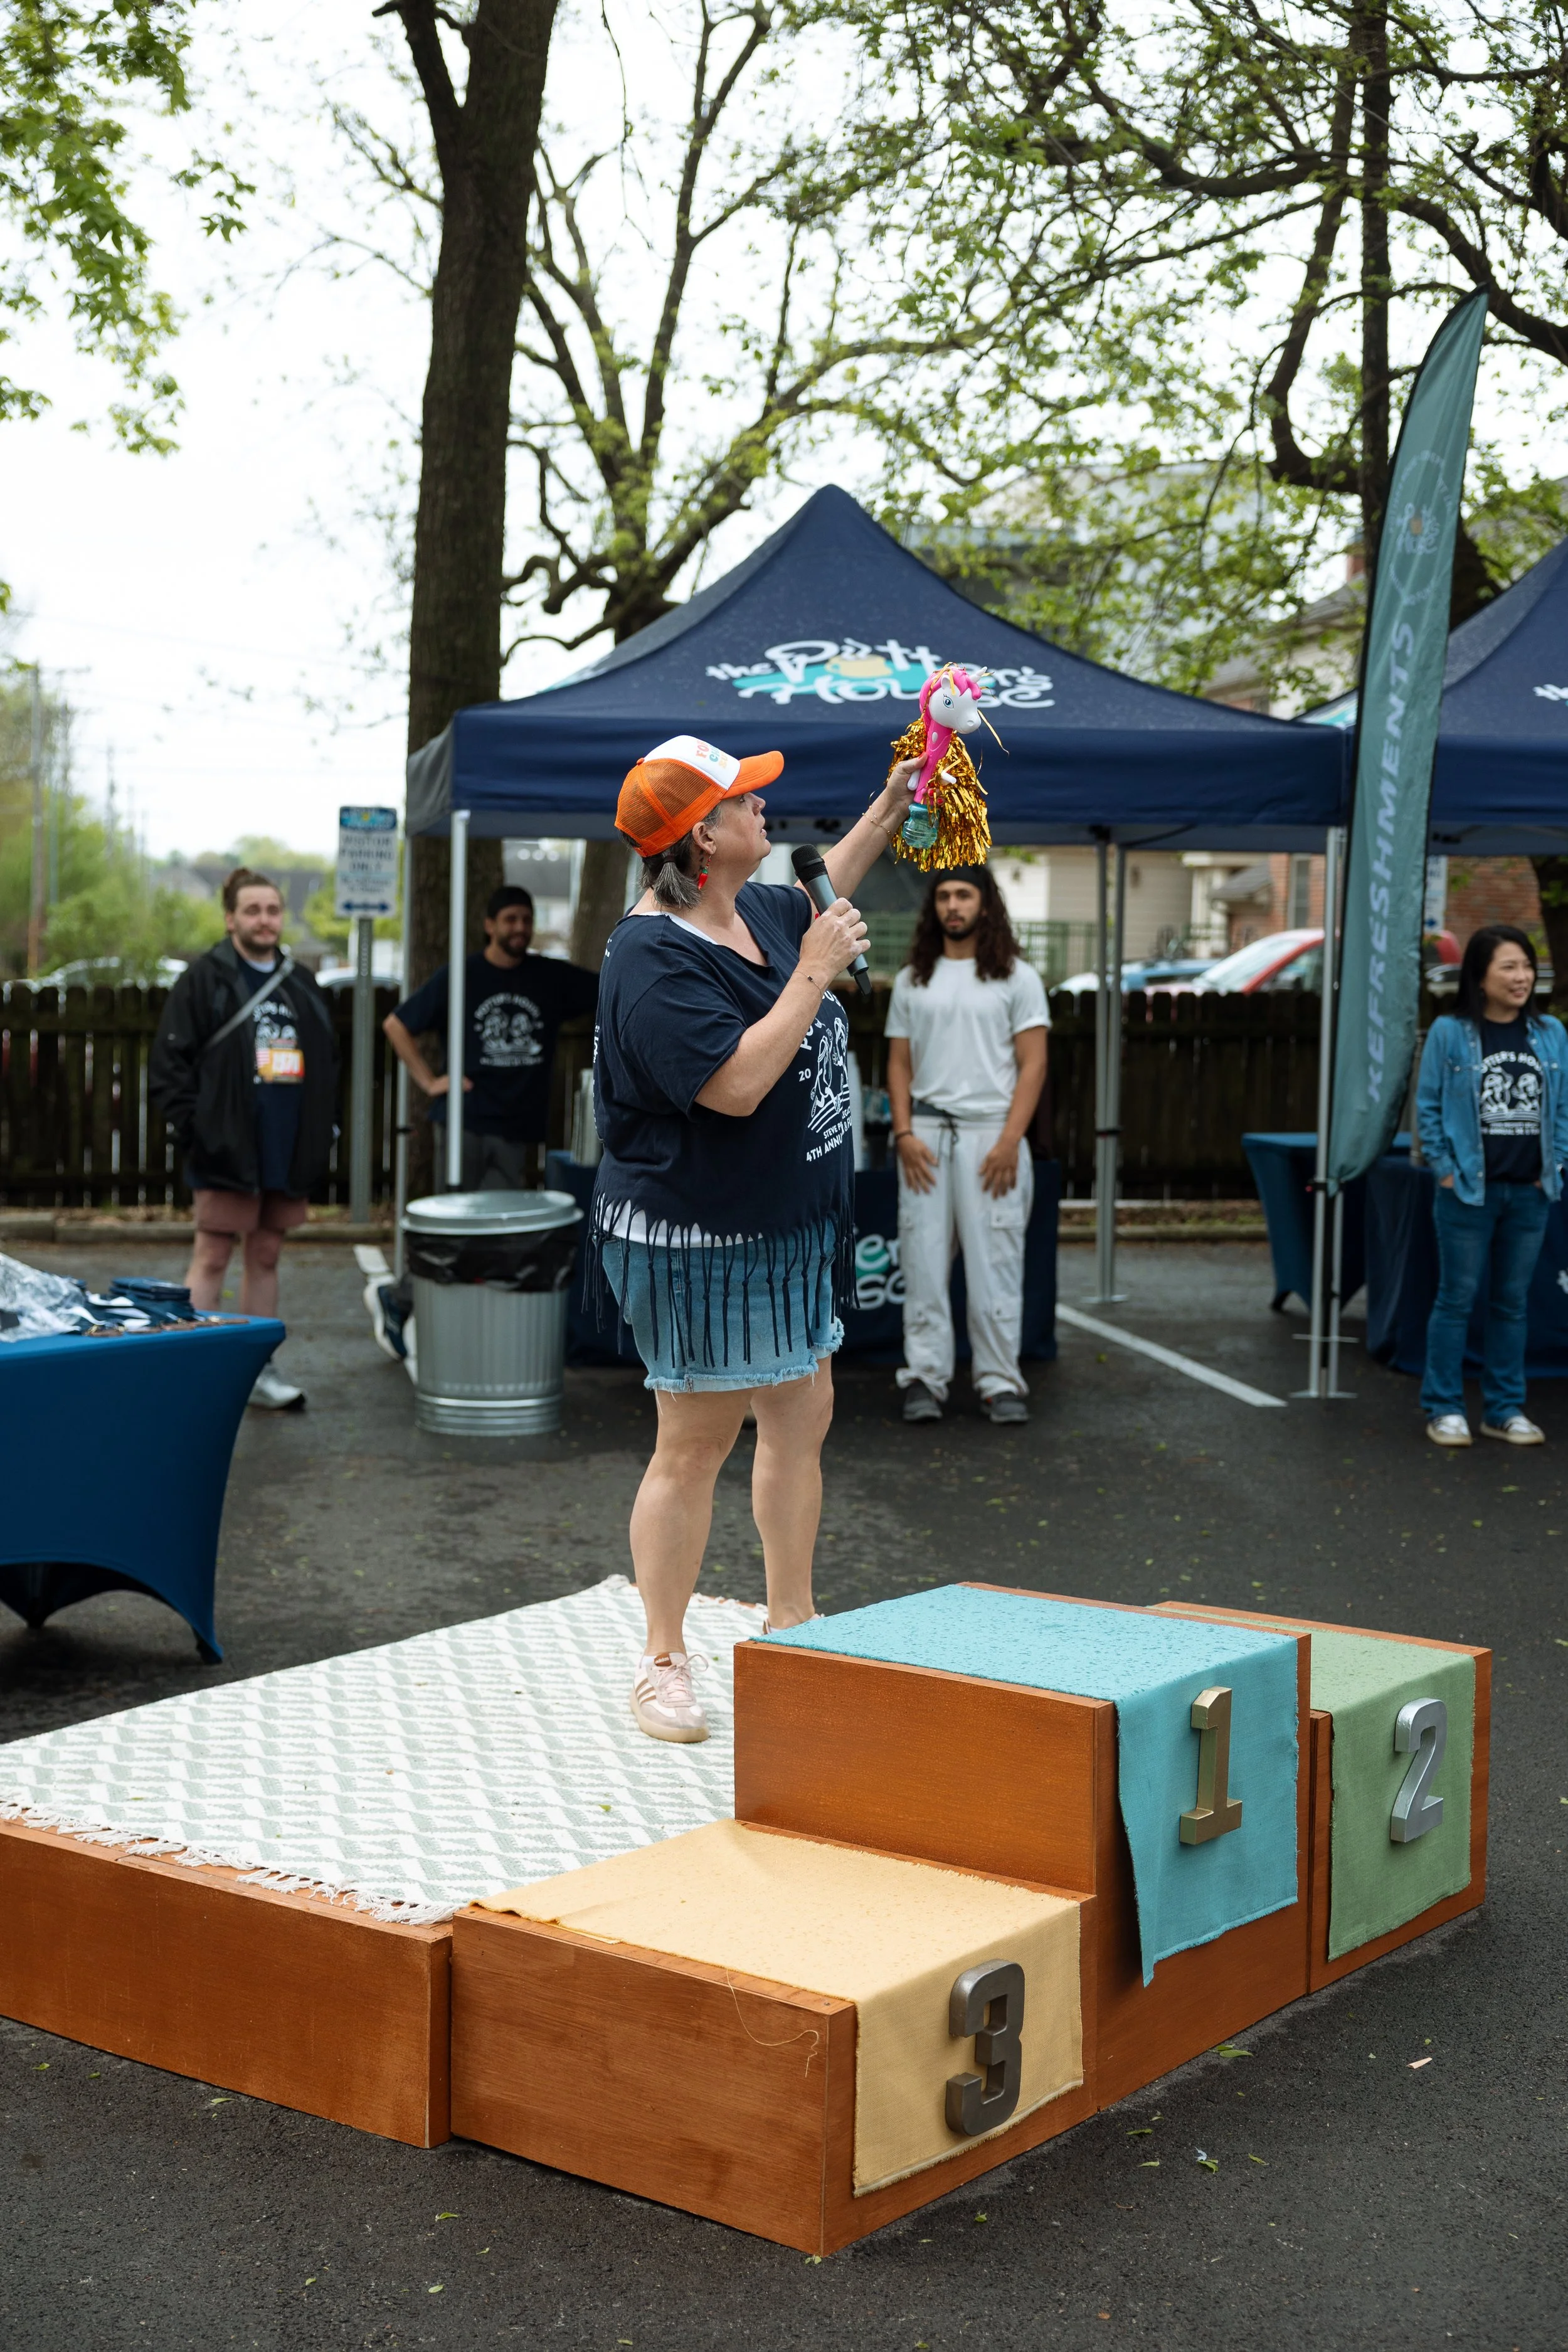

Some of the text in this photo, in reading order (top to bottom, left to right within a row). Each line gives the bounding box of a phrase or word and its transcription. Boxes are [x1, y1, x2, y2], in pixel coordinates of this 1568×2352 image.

[705, 662, 775, 681] the
[1532, 683, 1568, 701] th
[798, 1068, 812, 1082] 20
[1480, 1051, 1544, 1076] OTTER'S HOU
[823, 1124, 838, 1139] STEVE
[806, 1146, 823, 1162] 4TH
[824, 1133, 843, 1154] ANNU
[1179, 1686, 1243, 1845] 1
[1390, 1697, 1448, 1843] 2
[945, 1958, 1025, 2136] 3
